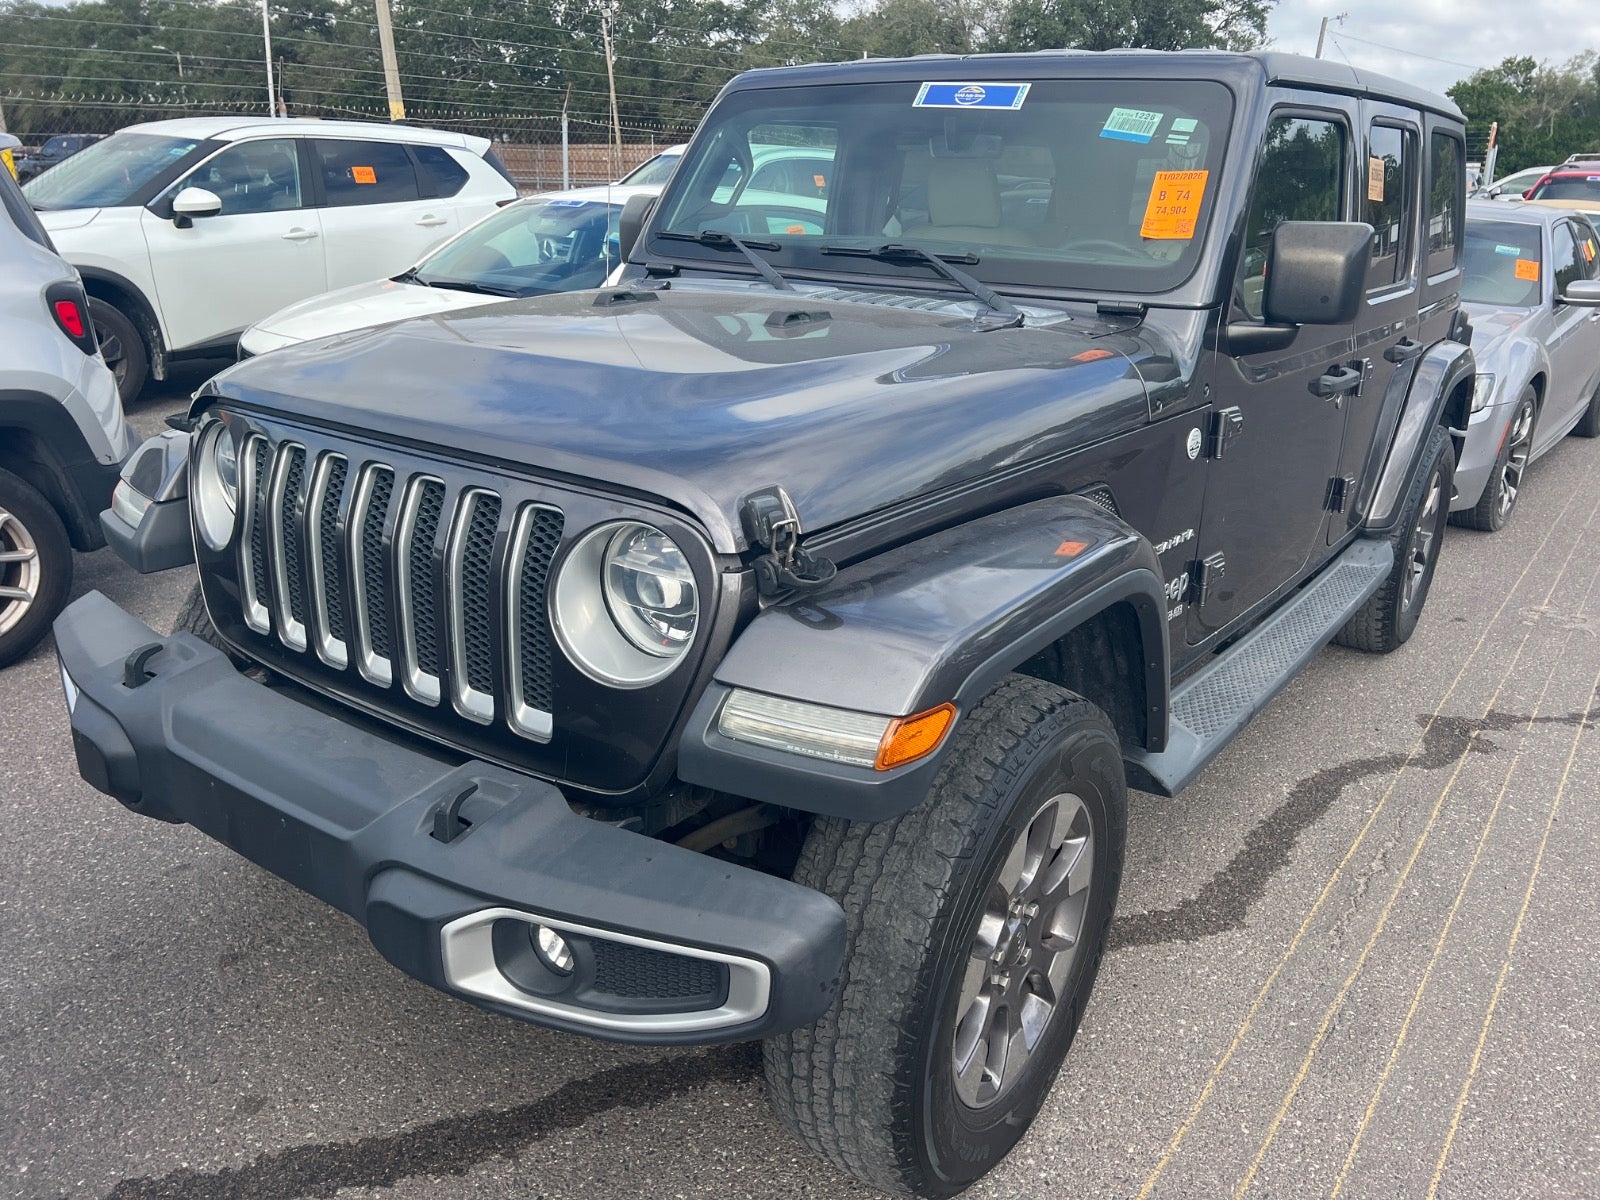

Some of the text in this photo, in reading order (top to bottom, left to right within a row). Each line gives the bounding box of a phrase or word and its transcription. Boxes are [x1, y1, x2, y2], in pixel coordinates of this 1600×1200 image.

[1158, 190, 1191, 201] B 74
[1165, 572, 1190, 602] eep
